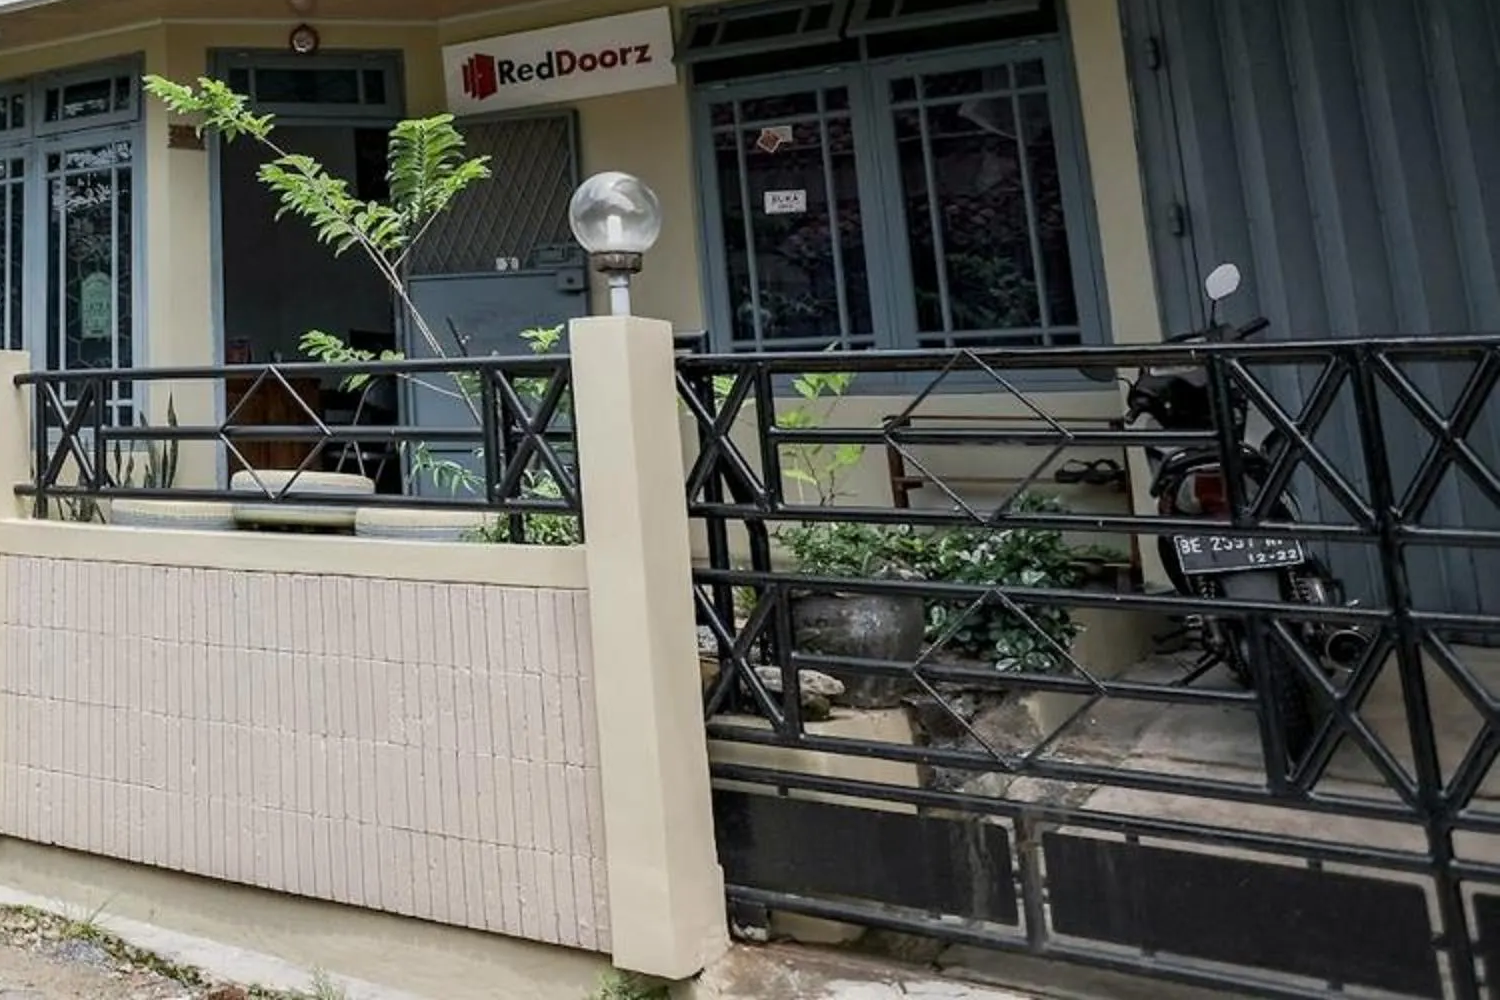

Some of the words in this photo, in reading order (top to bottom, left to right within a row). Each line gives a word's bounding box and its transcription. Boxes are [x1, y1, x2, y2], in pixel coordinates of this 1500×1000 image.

[497, 44, 652, 85] RedDoorz
[1181, 538, 1203, 554] BE
[1248, 549, 1298, 563] 12-22
